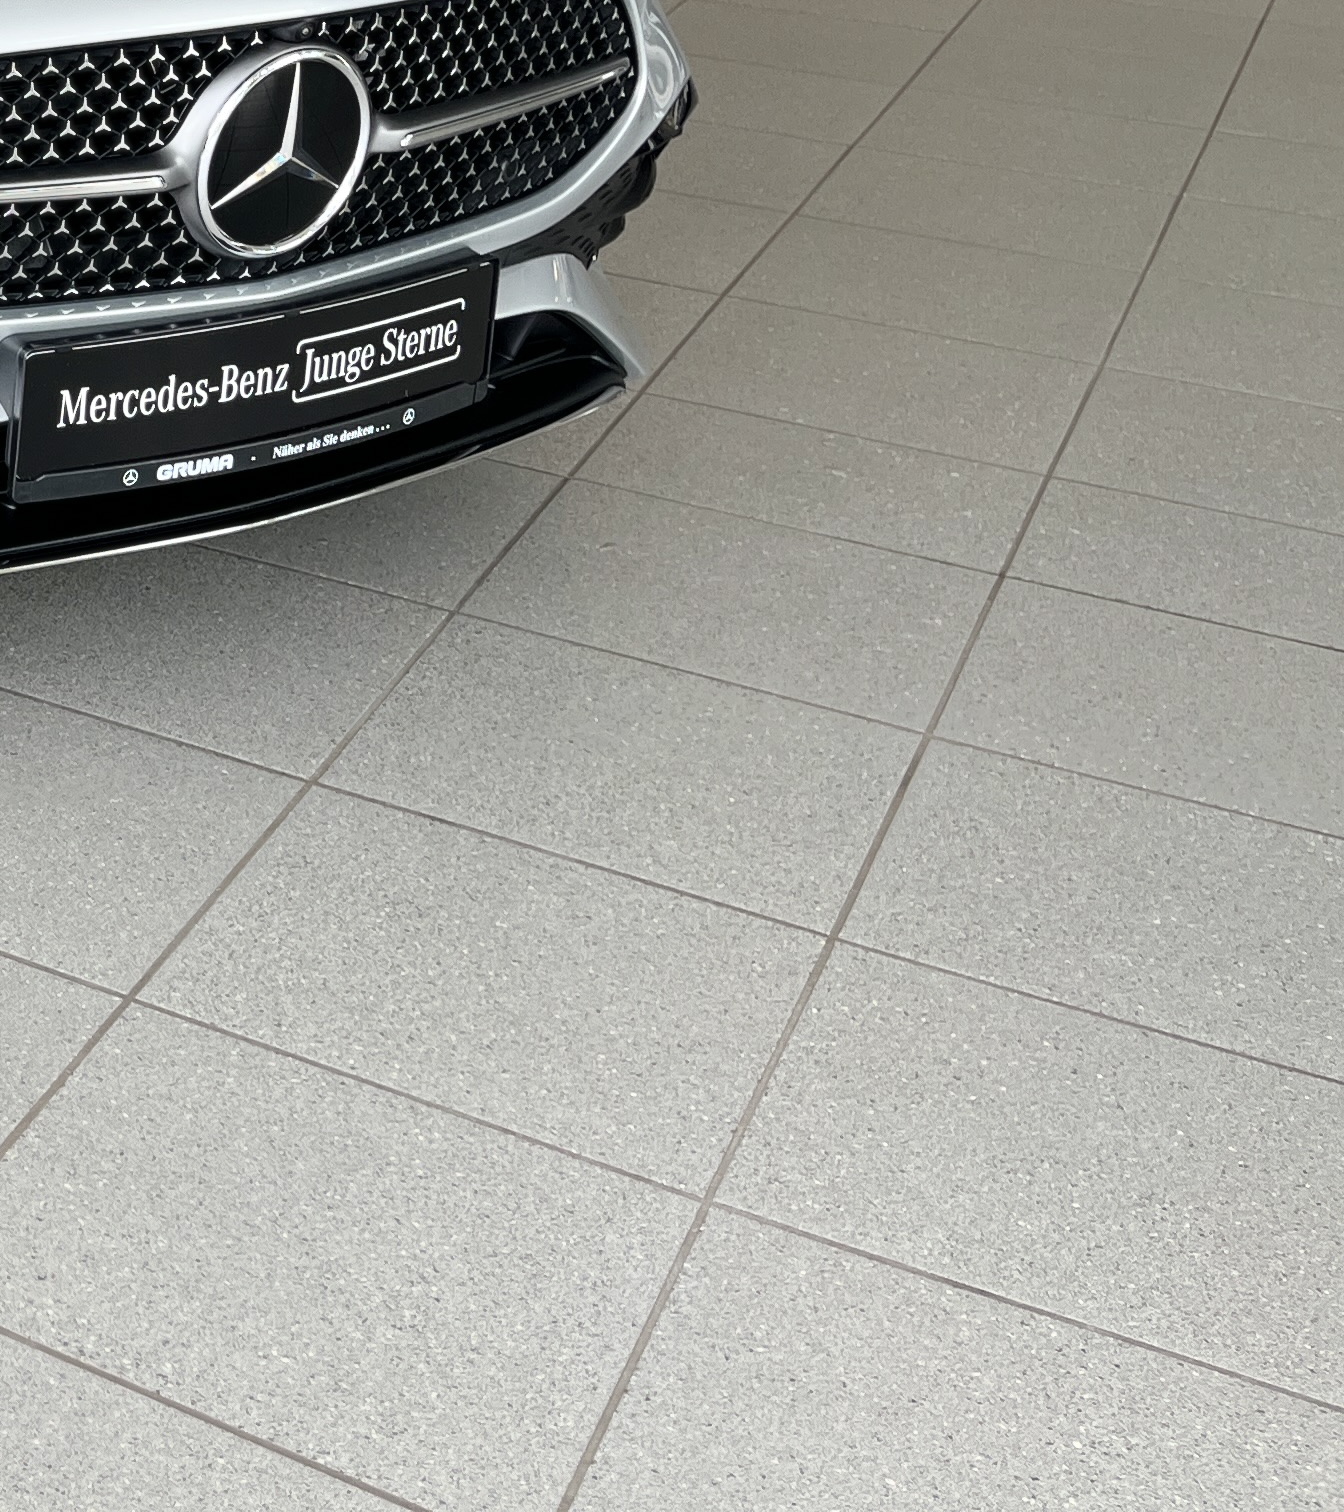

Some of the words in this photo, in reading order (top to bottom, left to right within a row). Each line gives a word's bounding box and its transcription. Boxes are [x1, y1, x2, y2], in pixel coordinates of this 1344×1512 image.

[56, 363, 290, 428] Mercedes-Benz
[299, 343, 375, 393] Junge
[380, 319, 458, 367] Sterne
[156, 453, 234, 481] GRUMA
[272, 444, 305, 459] Näher
[307, 437, 321, 451] als
[322, 433, 338, 448] Sie
